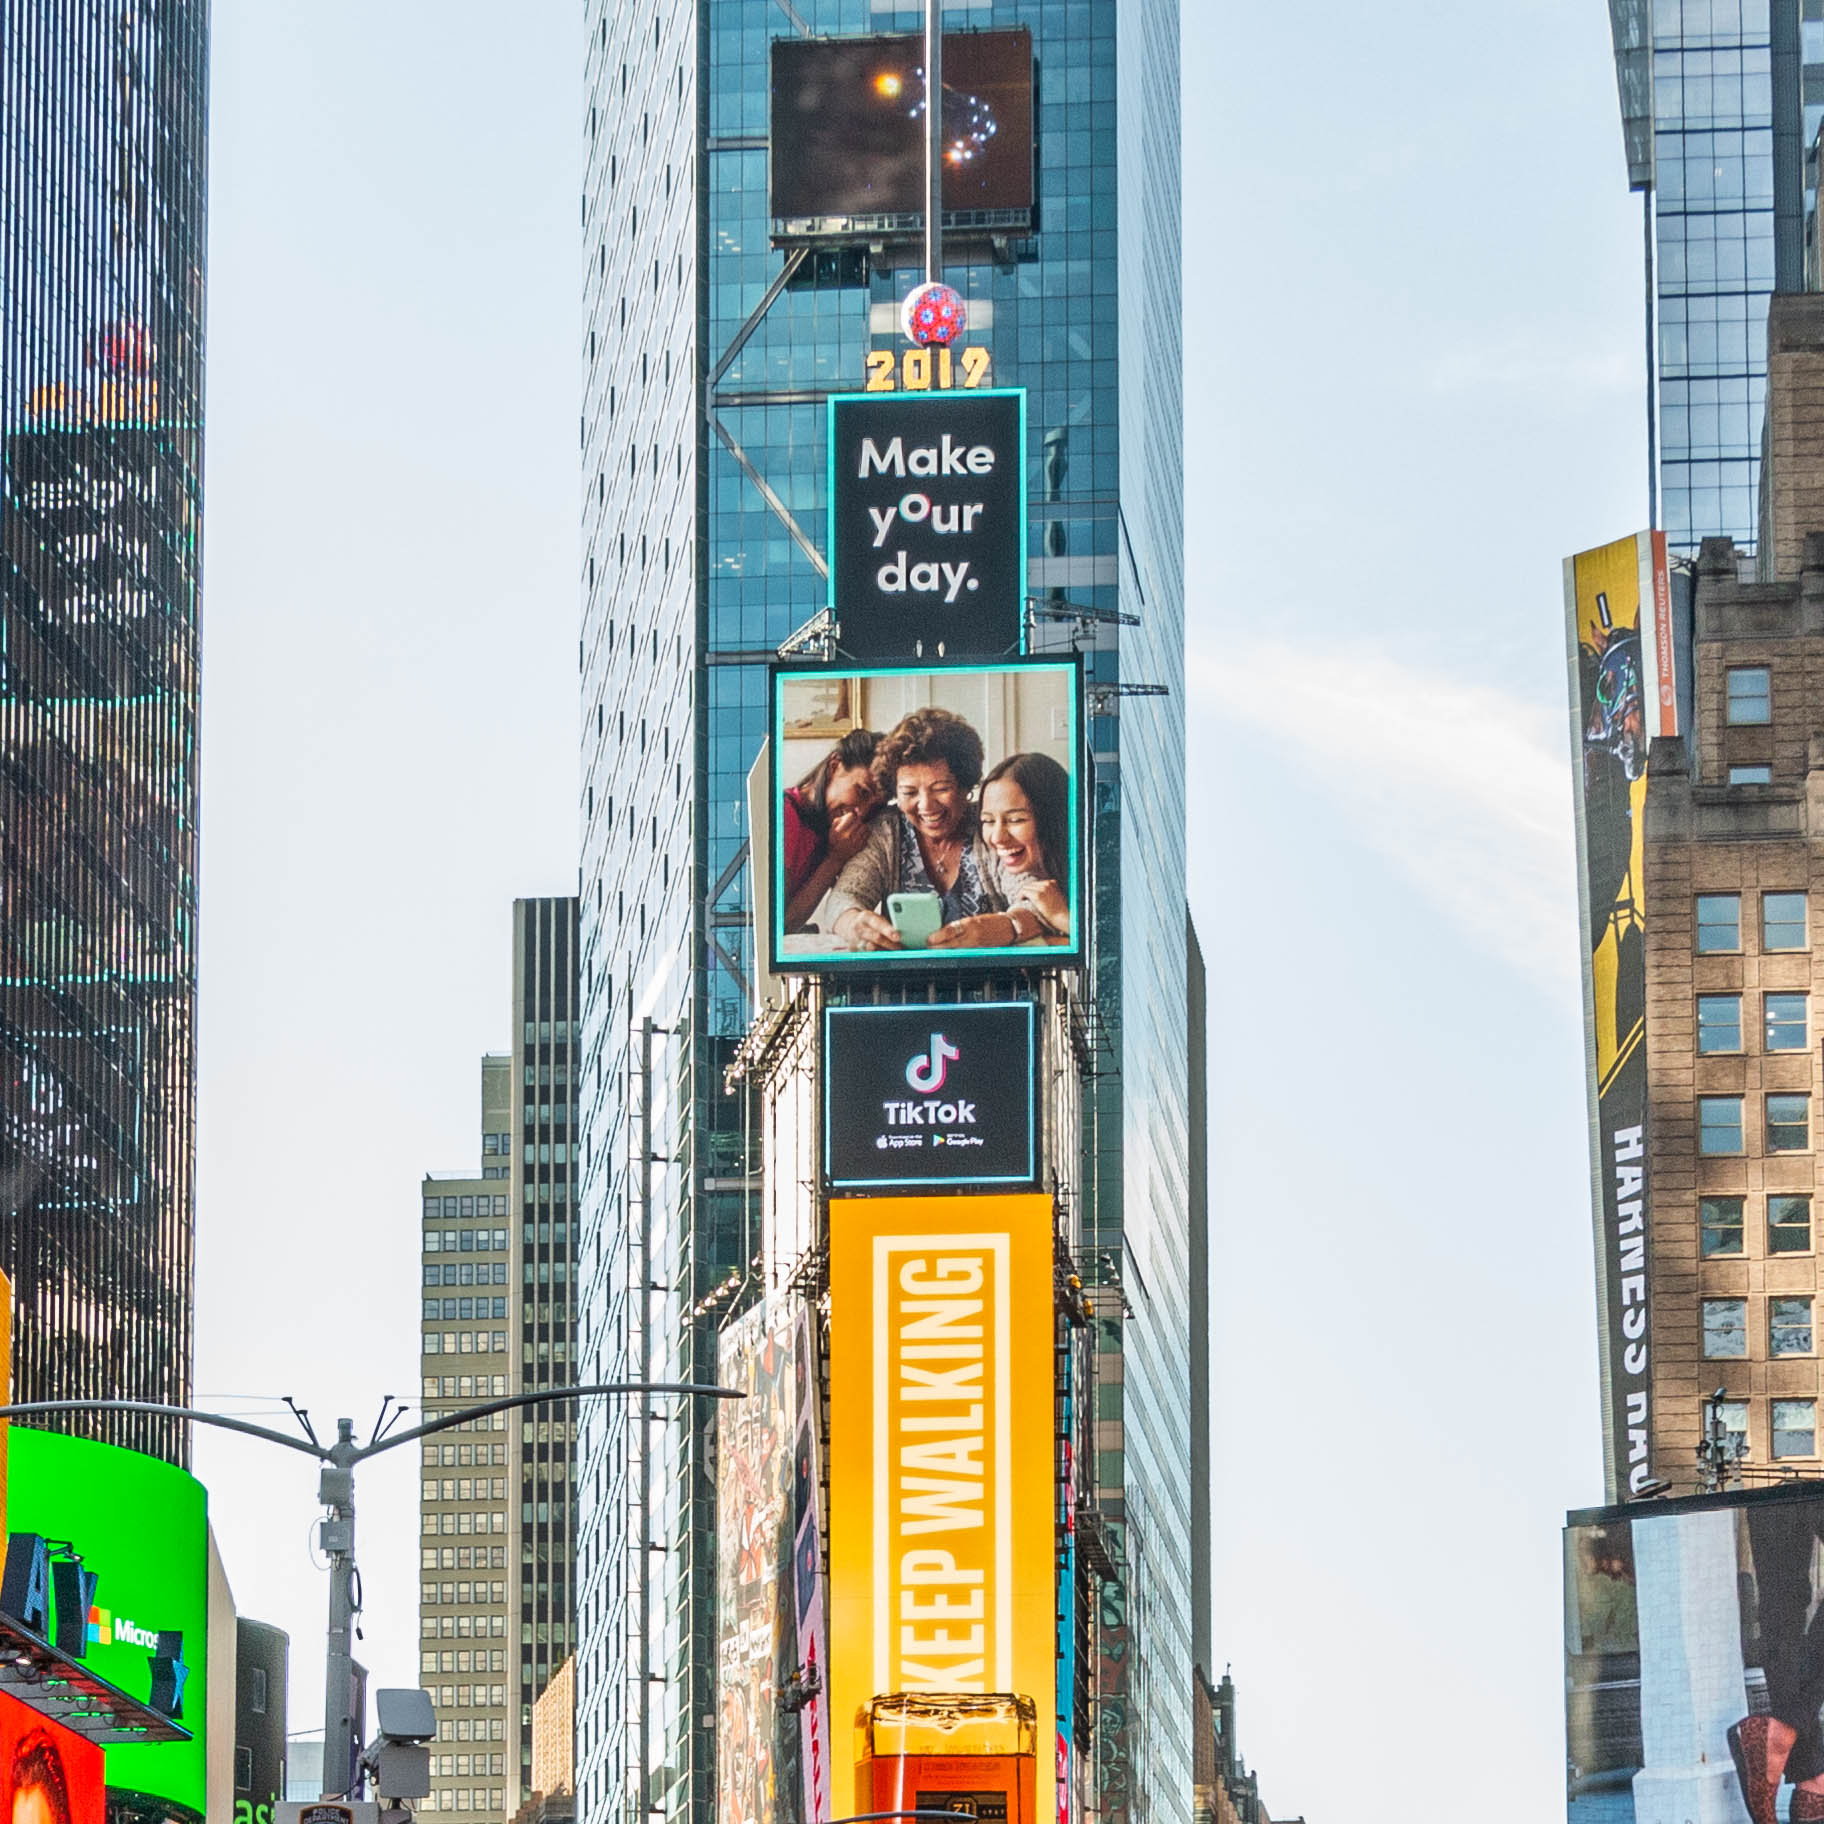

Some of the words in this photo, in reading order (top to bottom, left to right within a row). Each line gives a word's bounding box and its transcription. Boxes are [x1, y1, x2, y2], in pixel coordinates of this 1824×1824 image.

[865, 347, 991, 393] 2019
[858, 434, 996, 480] Make
[868, 492, 983, 547] your
[877, 551, 980, 604] day.
[1656, 568, 1671, 617] REUTERS
[1659, 617, 1674, 679] THOMSON
[883, 1099, 977, 1125] TikTok
[889, 1139, 904, 1148] App
[1609, 1123, 1650, 1375] HARNESS
[900, 1256, 985, 1547] WALKING
[900, 1548, 985, 1695] KEEP
